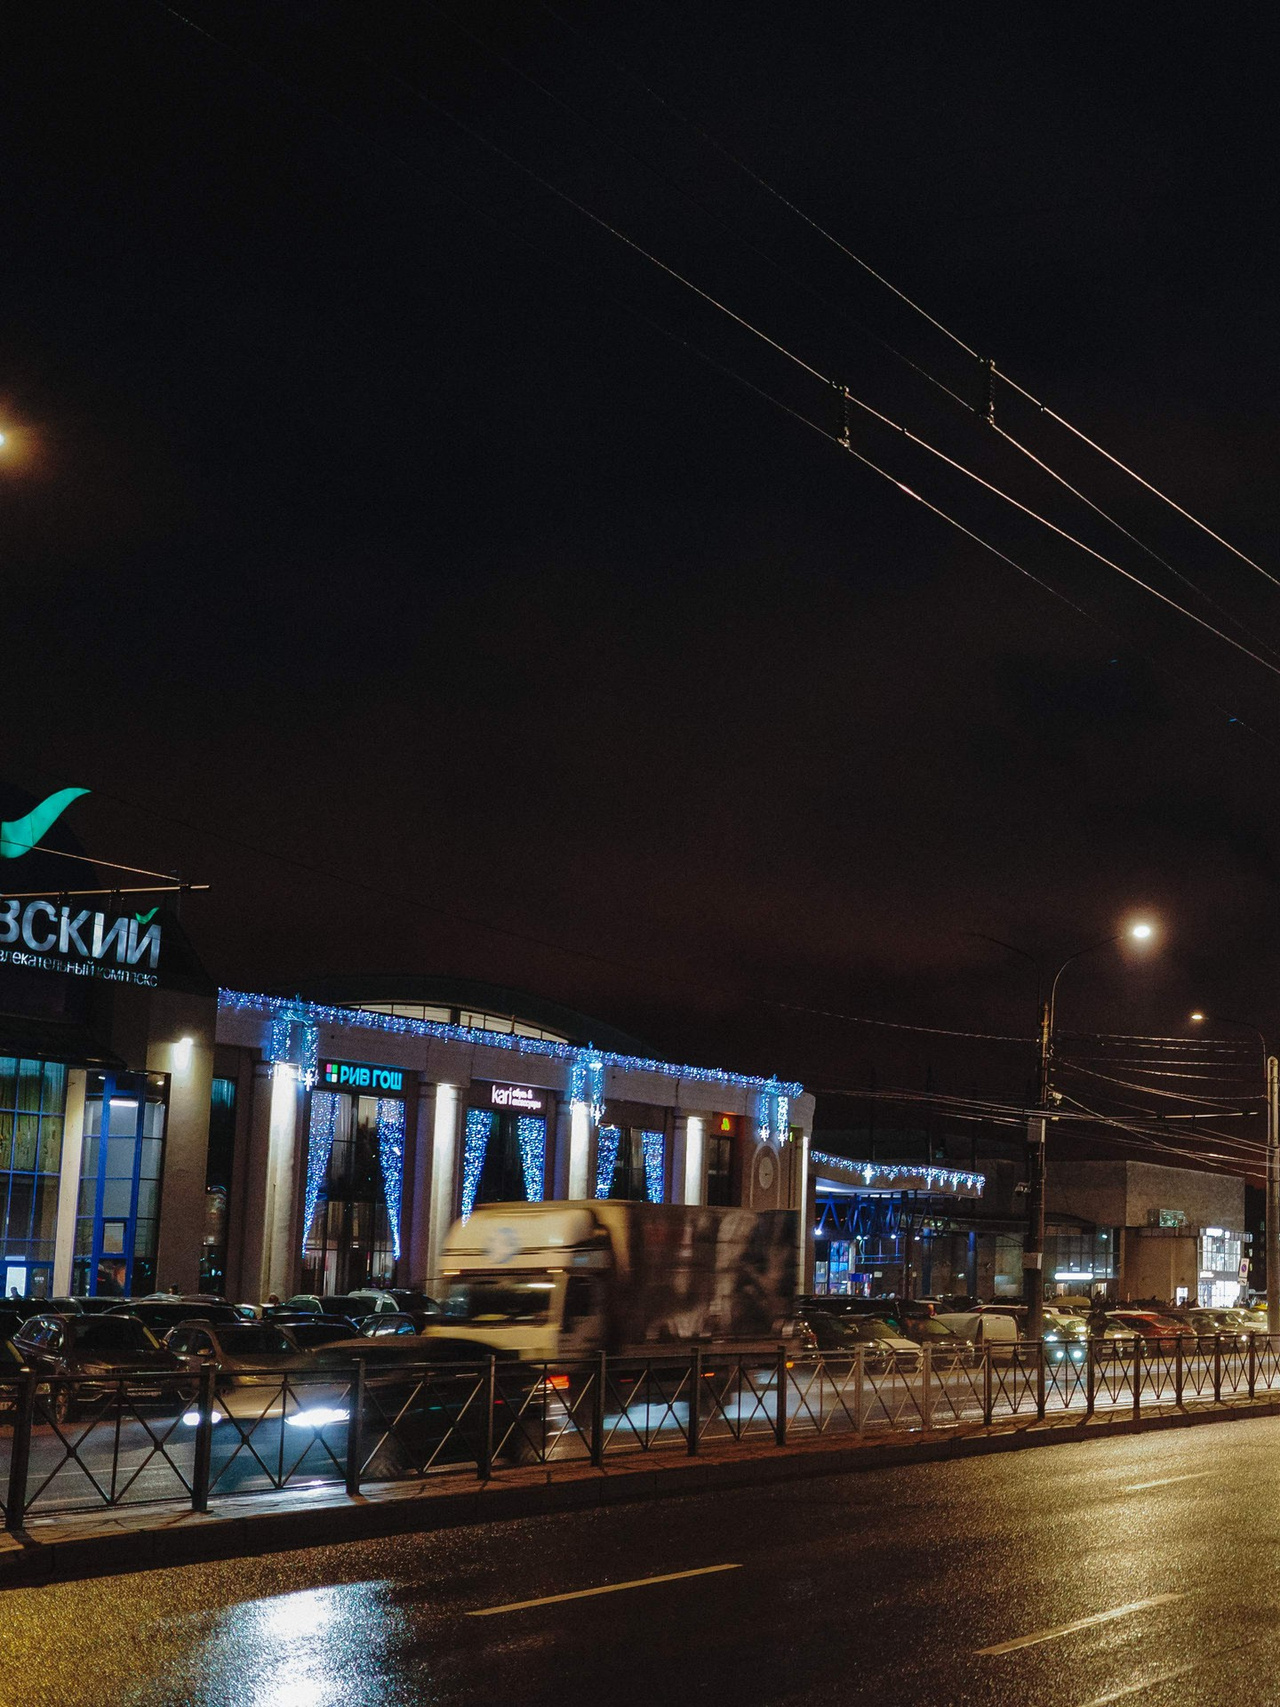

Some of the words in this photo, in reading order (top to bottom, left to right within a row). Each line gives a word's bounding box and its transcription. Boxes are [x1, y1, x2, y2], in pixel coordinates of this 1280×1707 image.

[340, 1065, 370, 1087] РИВ
[372, 1069, 402, 1090] ГОШ
[491, 1084, 512, 1105] kari
